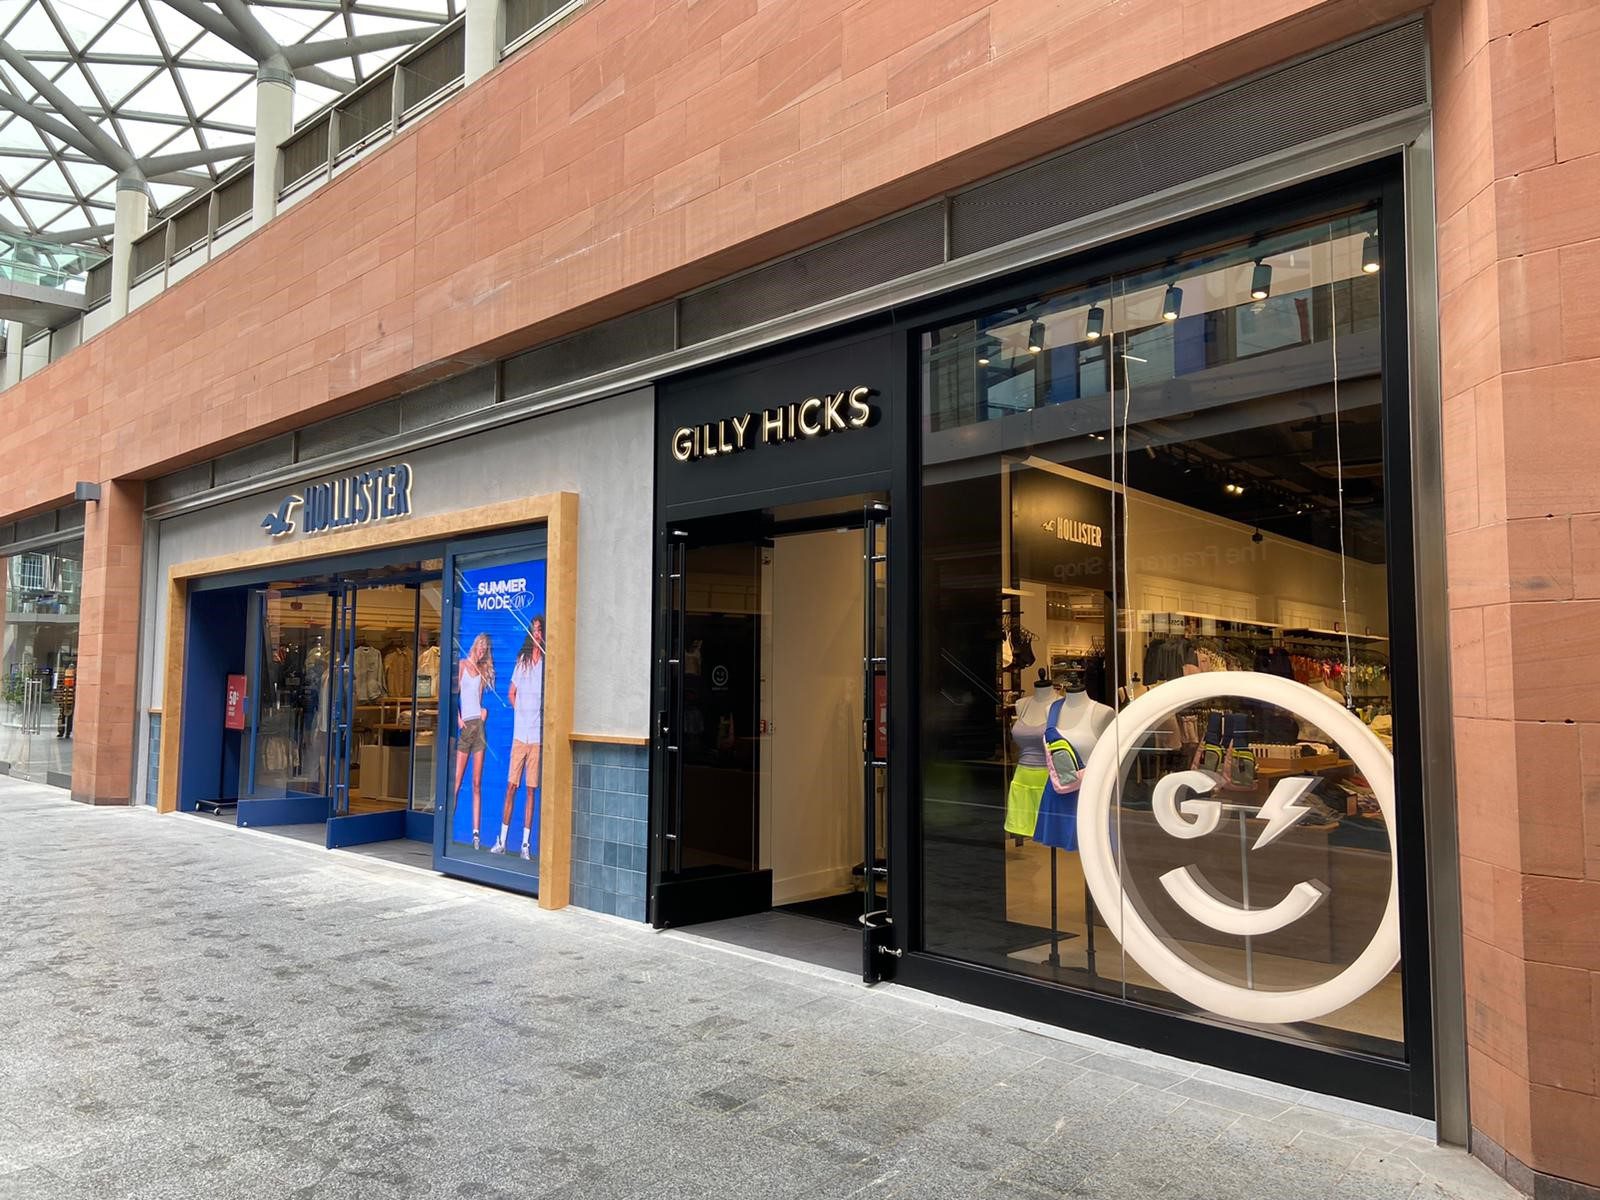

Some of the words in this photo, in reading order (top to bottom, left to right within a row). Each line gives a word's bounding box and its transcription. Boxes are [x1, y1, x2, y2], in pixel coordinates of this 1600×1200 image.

[671, 412, 751, 462] GILLY
[762, 384, 870, 443] HICKS
[303, 463, 412, 533] HOLLISTER
[1056, 516, 1102, 548] HOLLISTER
[477, 578, 526, 595] SUMMER
[477, 595, 511, 611] MODE
[1152, 770, 1222, 839] G
